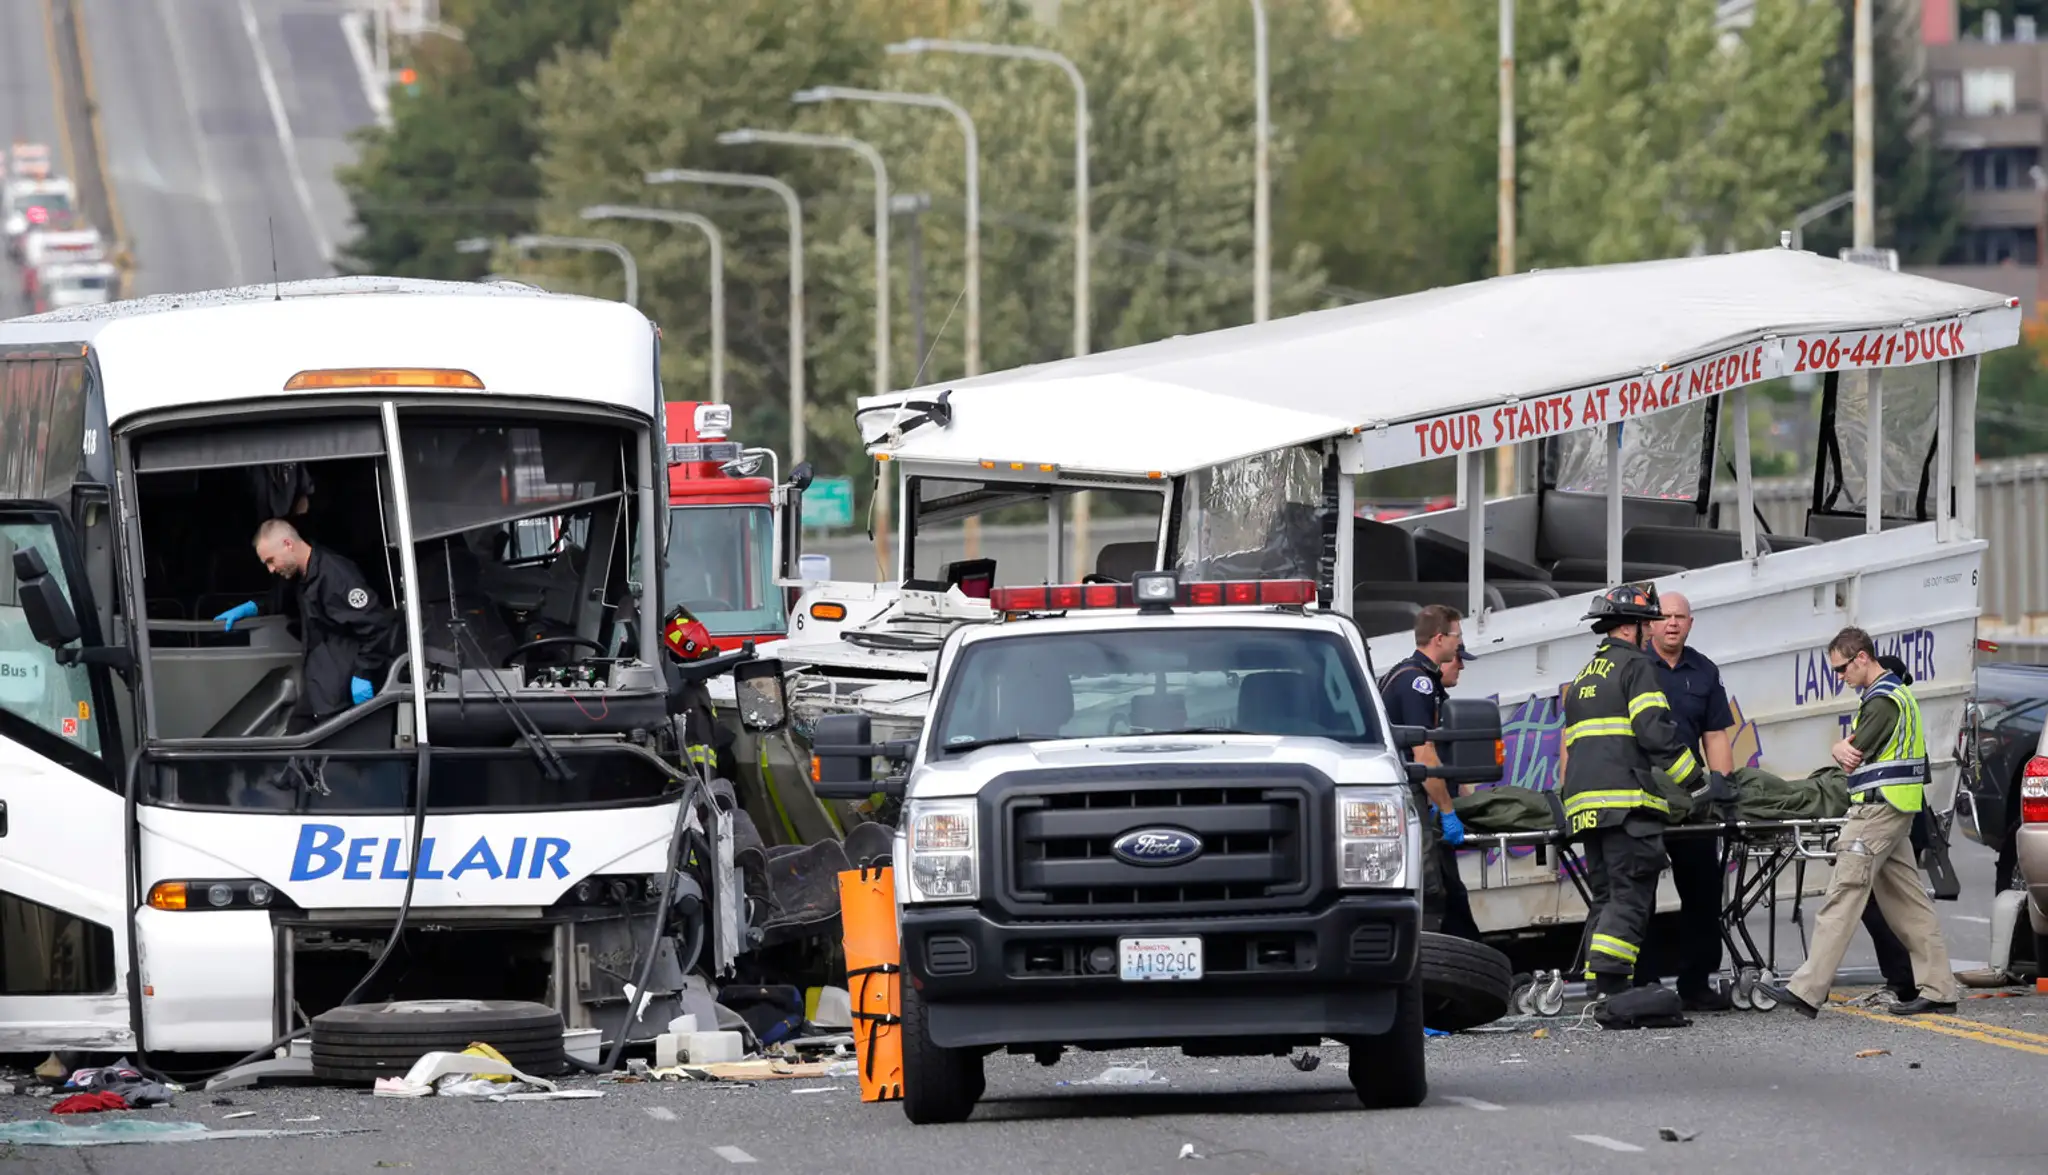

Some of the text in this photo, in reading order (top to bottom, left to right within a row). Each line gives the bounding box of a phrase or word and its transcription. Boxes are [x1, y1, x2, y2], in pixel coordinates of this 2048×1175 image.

[1794, 322, 1966, 372] 206-441-DUCK
[1414, 346, 1763, 457] TOUR STARTS AT SPACE NEEDLE
[1972, 569, 1979, 586] 6
[796, 613, 804, 630] 6
[685, 641, 695, 651] 6
[1, 663, 38, 678] Bus 1
[1579, 685, 1597, 699] FIRE
[1134, 834, 1181, 854] Ford
[1136, 952, 1196, 972] A1929C
